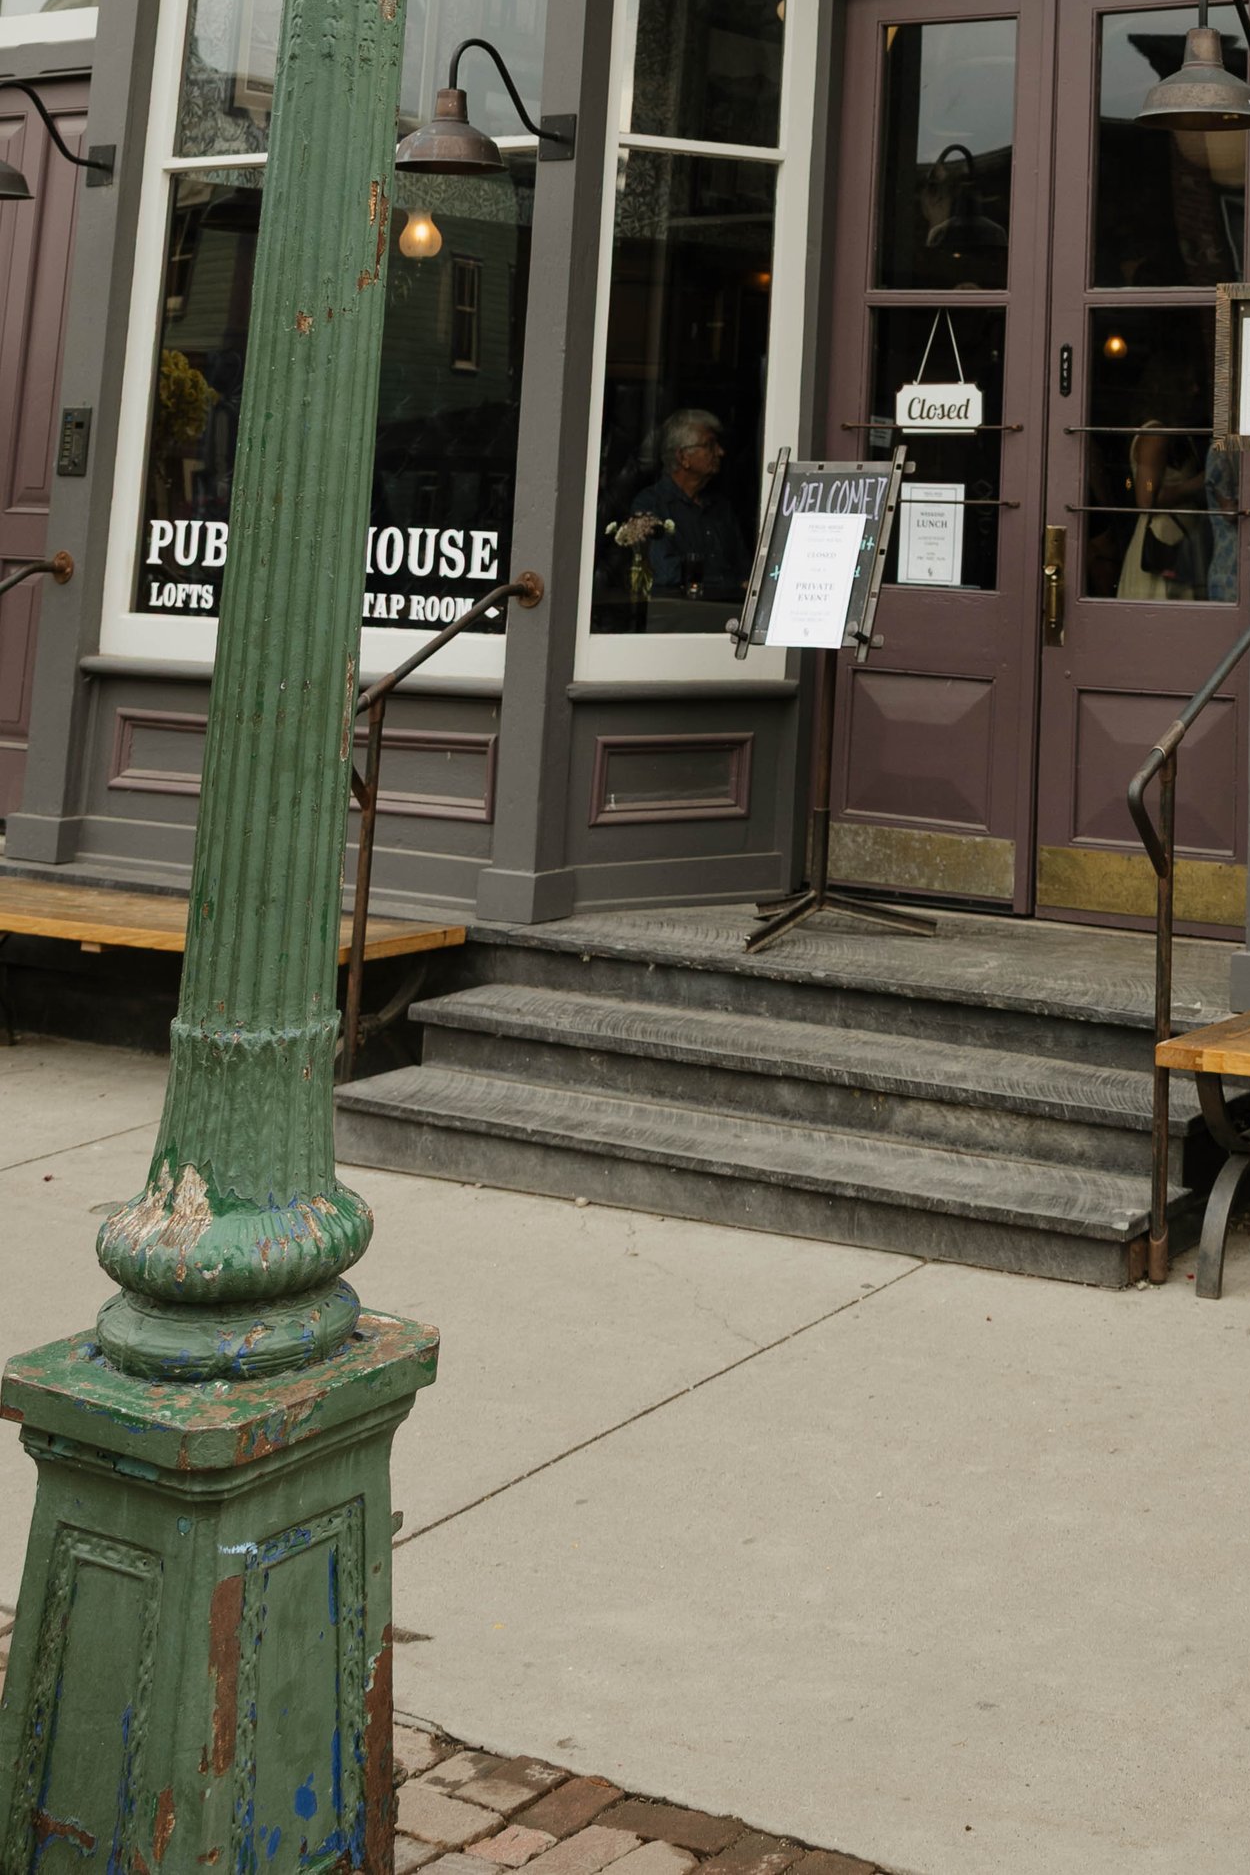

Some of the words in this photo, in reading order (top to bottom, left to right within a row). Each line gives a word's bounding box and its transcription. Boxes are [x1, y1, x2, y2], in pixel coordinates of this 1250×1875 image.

[907, 396, 970, 421] Closed
[916, 519, 948, 529] LUNCH
[146, 519, 229, 567] PUB
[795, 582, 834, 592] PRIVATE
[148, 581, 214, 610] LOFTS
[361, 592, 405, 619] TAP
[408, 594, 475, 623] ROOM
[797, 593, 829, 603] EVENT
